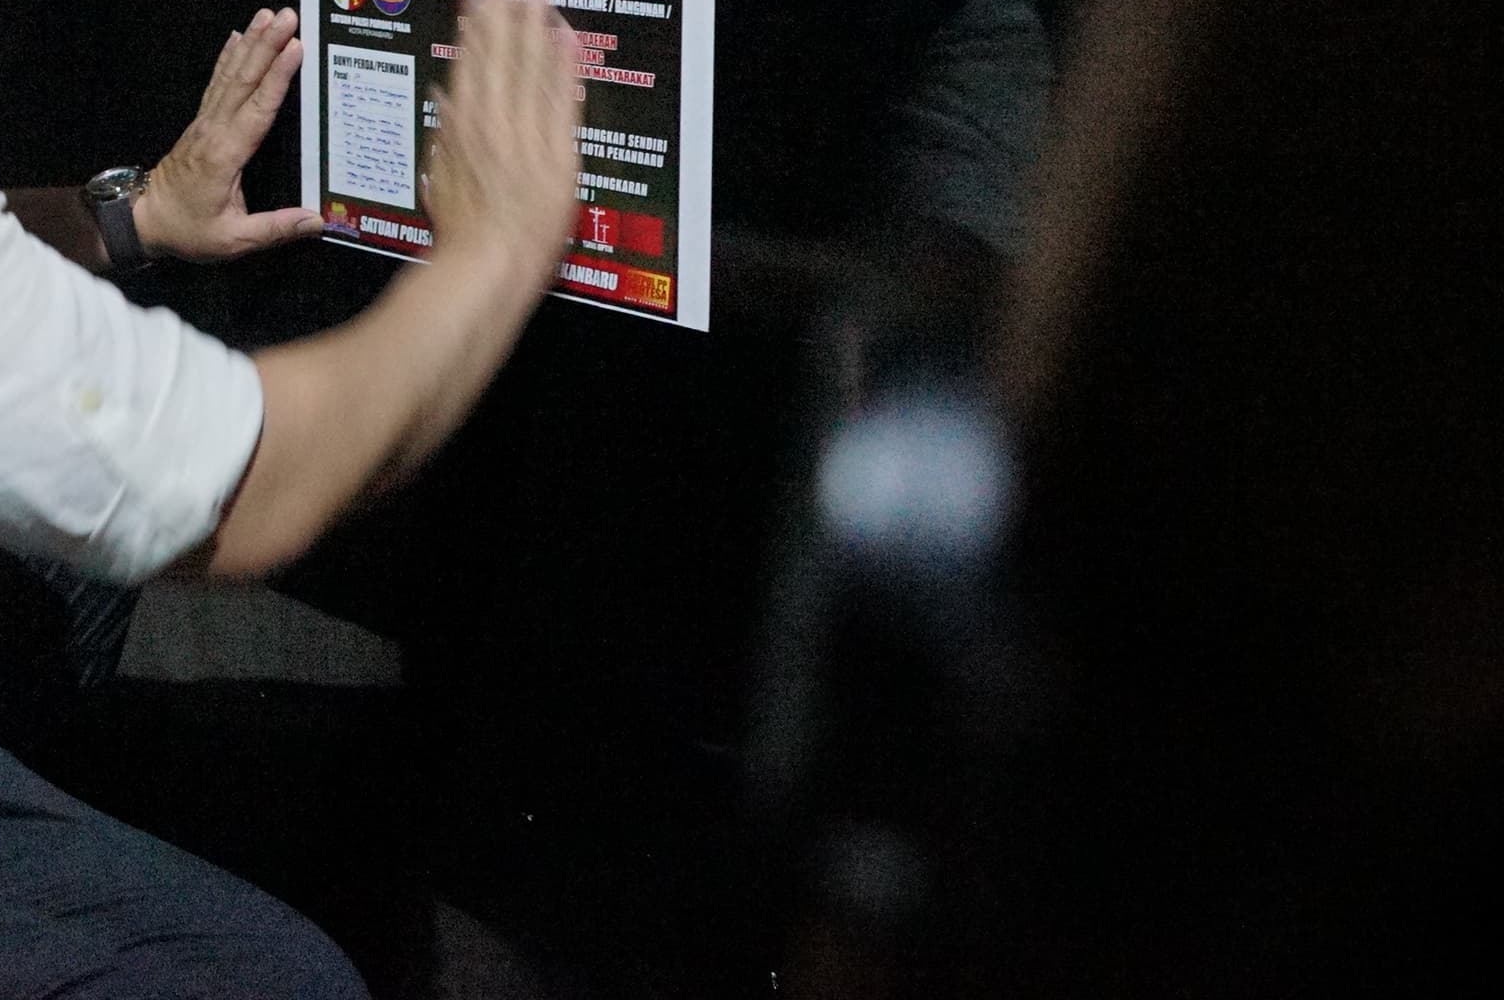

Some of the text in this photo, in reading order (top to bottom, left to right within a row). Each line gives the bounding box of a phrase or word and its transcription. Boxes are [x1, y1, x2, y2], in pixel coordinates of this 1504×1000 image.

[614, 0, 665, 18] BANGUNAN
[582, 32, 618, 50] DAERAH
[333, 55, 352, 68] BUNYI
[592, 66, 655, 88] MASYARAKAT
[627, 132, 668, 153] SENDIRI
[581, 143, 606, 159] KOTA
[607, 146, 664, 168] PEKANBARU
[577, 171, 648, 197] EMBONGKARAN
[360, 215, 399, 239] SATUAN
[561, 262, 618, 291] KANBARU
